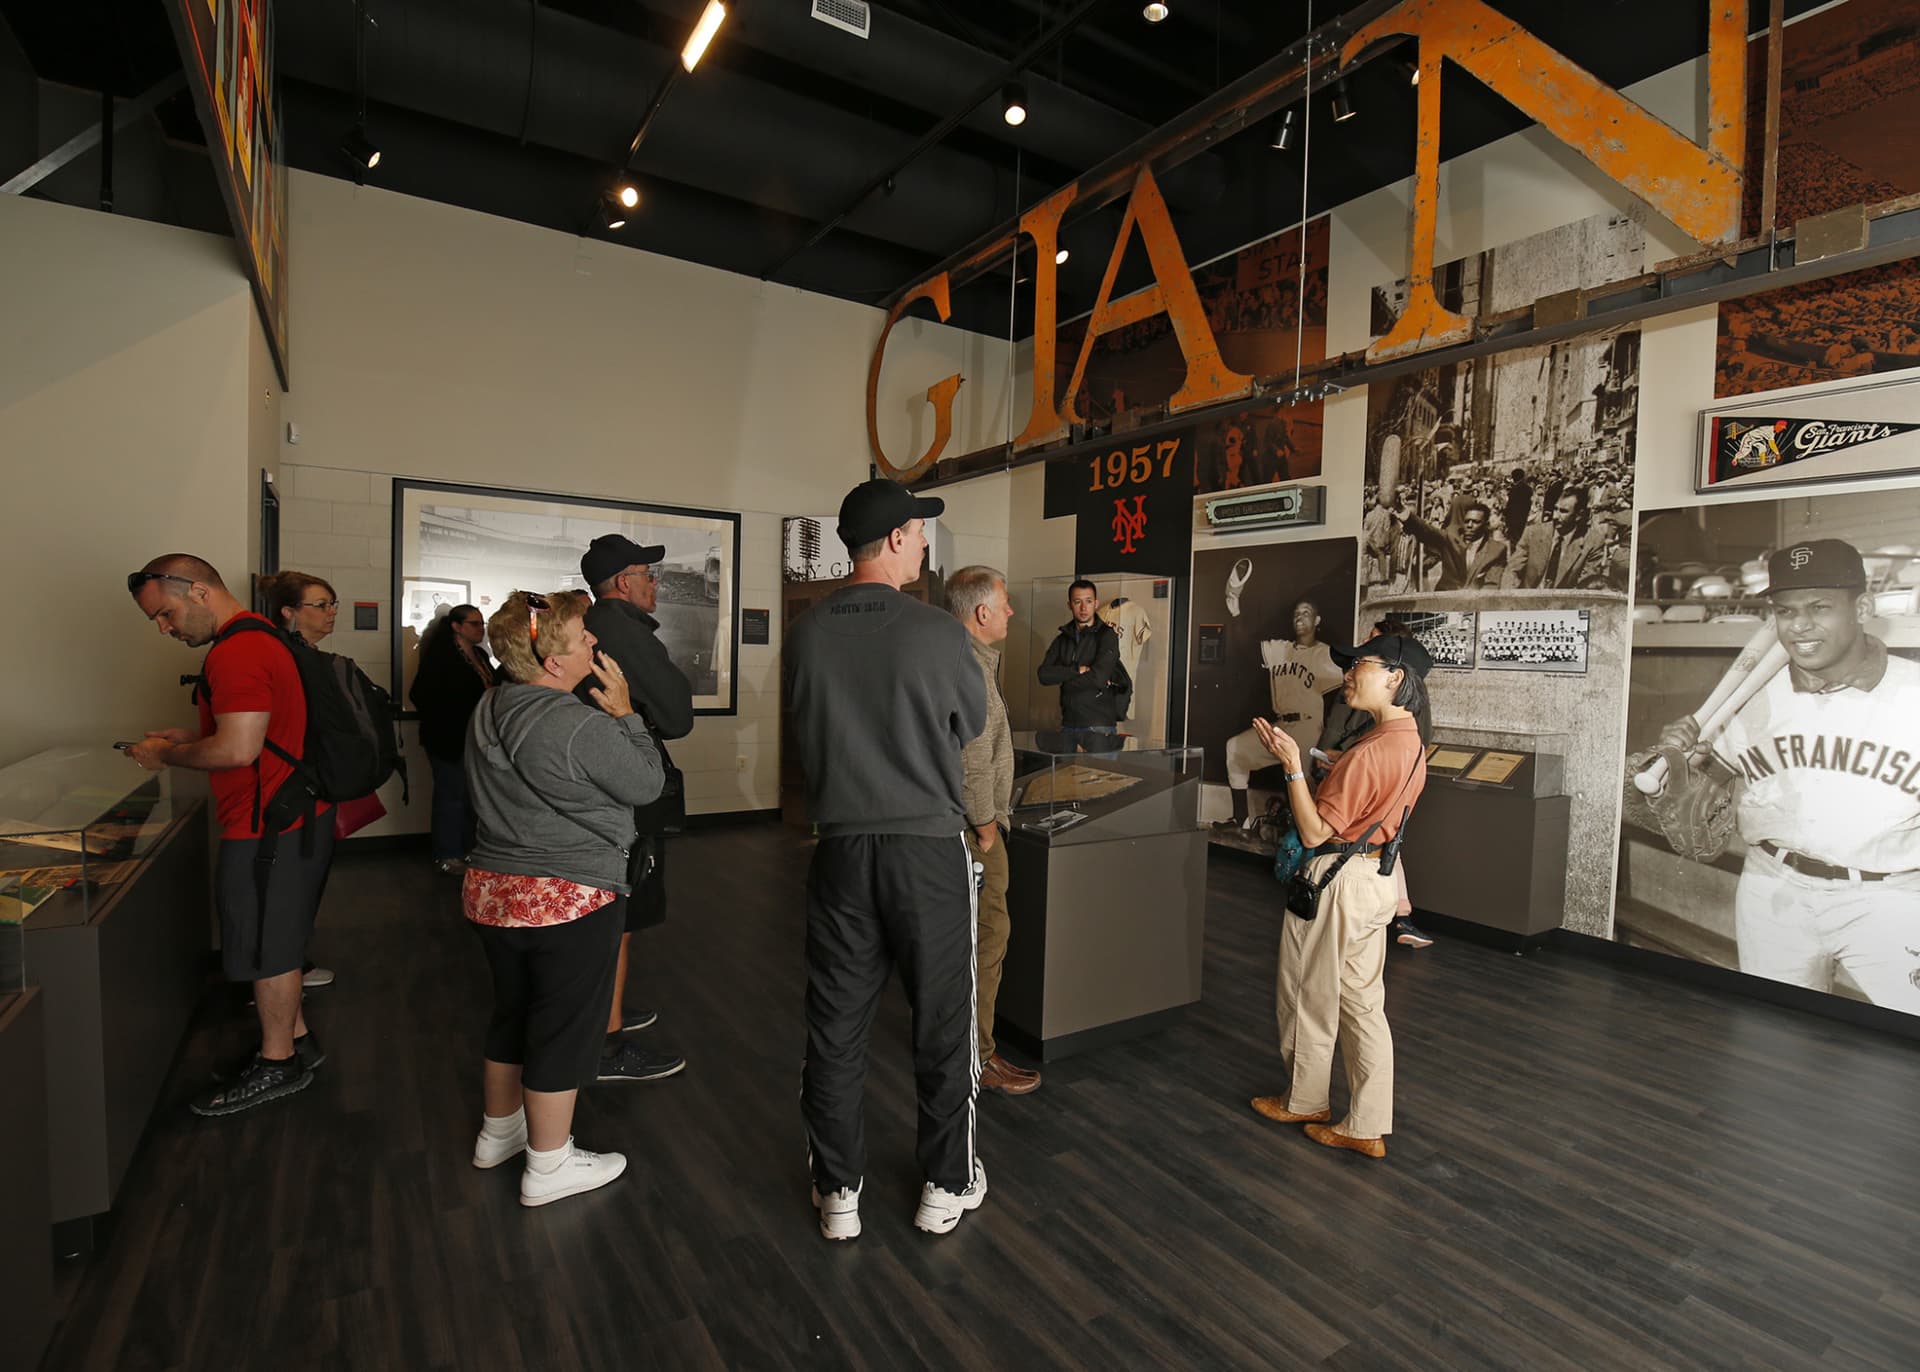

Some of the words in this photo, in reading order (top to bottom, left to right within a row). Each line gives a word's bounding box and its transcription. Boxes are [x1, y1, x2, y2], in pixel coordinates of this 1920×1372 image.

[1794, 421, 1898, 459] Giants
[1089, 438, 1180, 492] 1957
[1790, 546, 1814, 570] SF
[1773, 734, 1920, 804] FRANCISC
